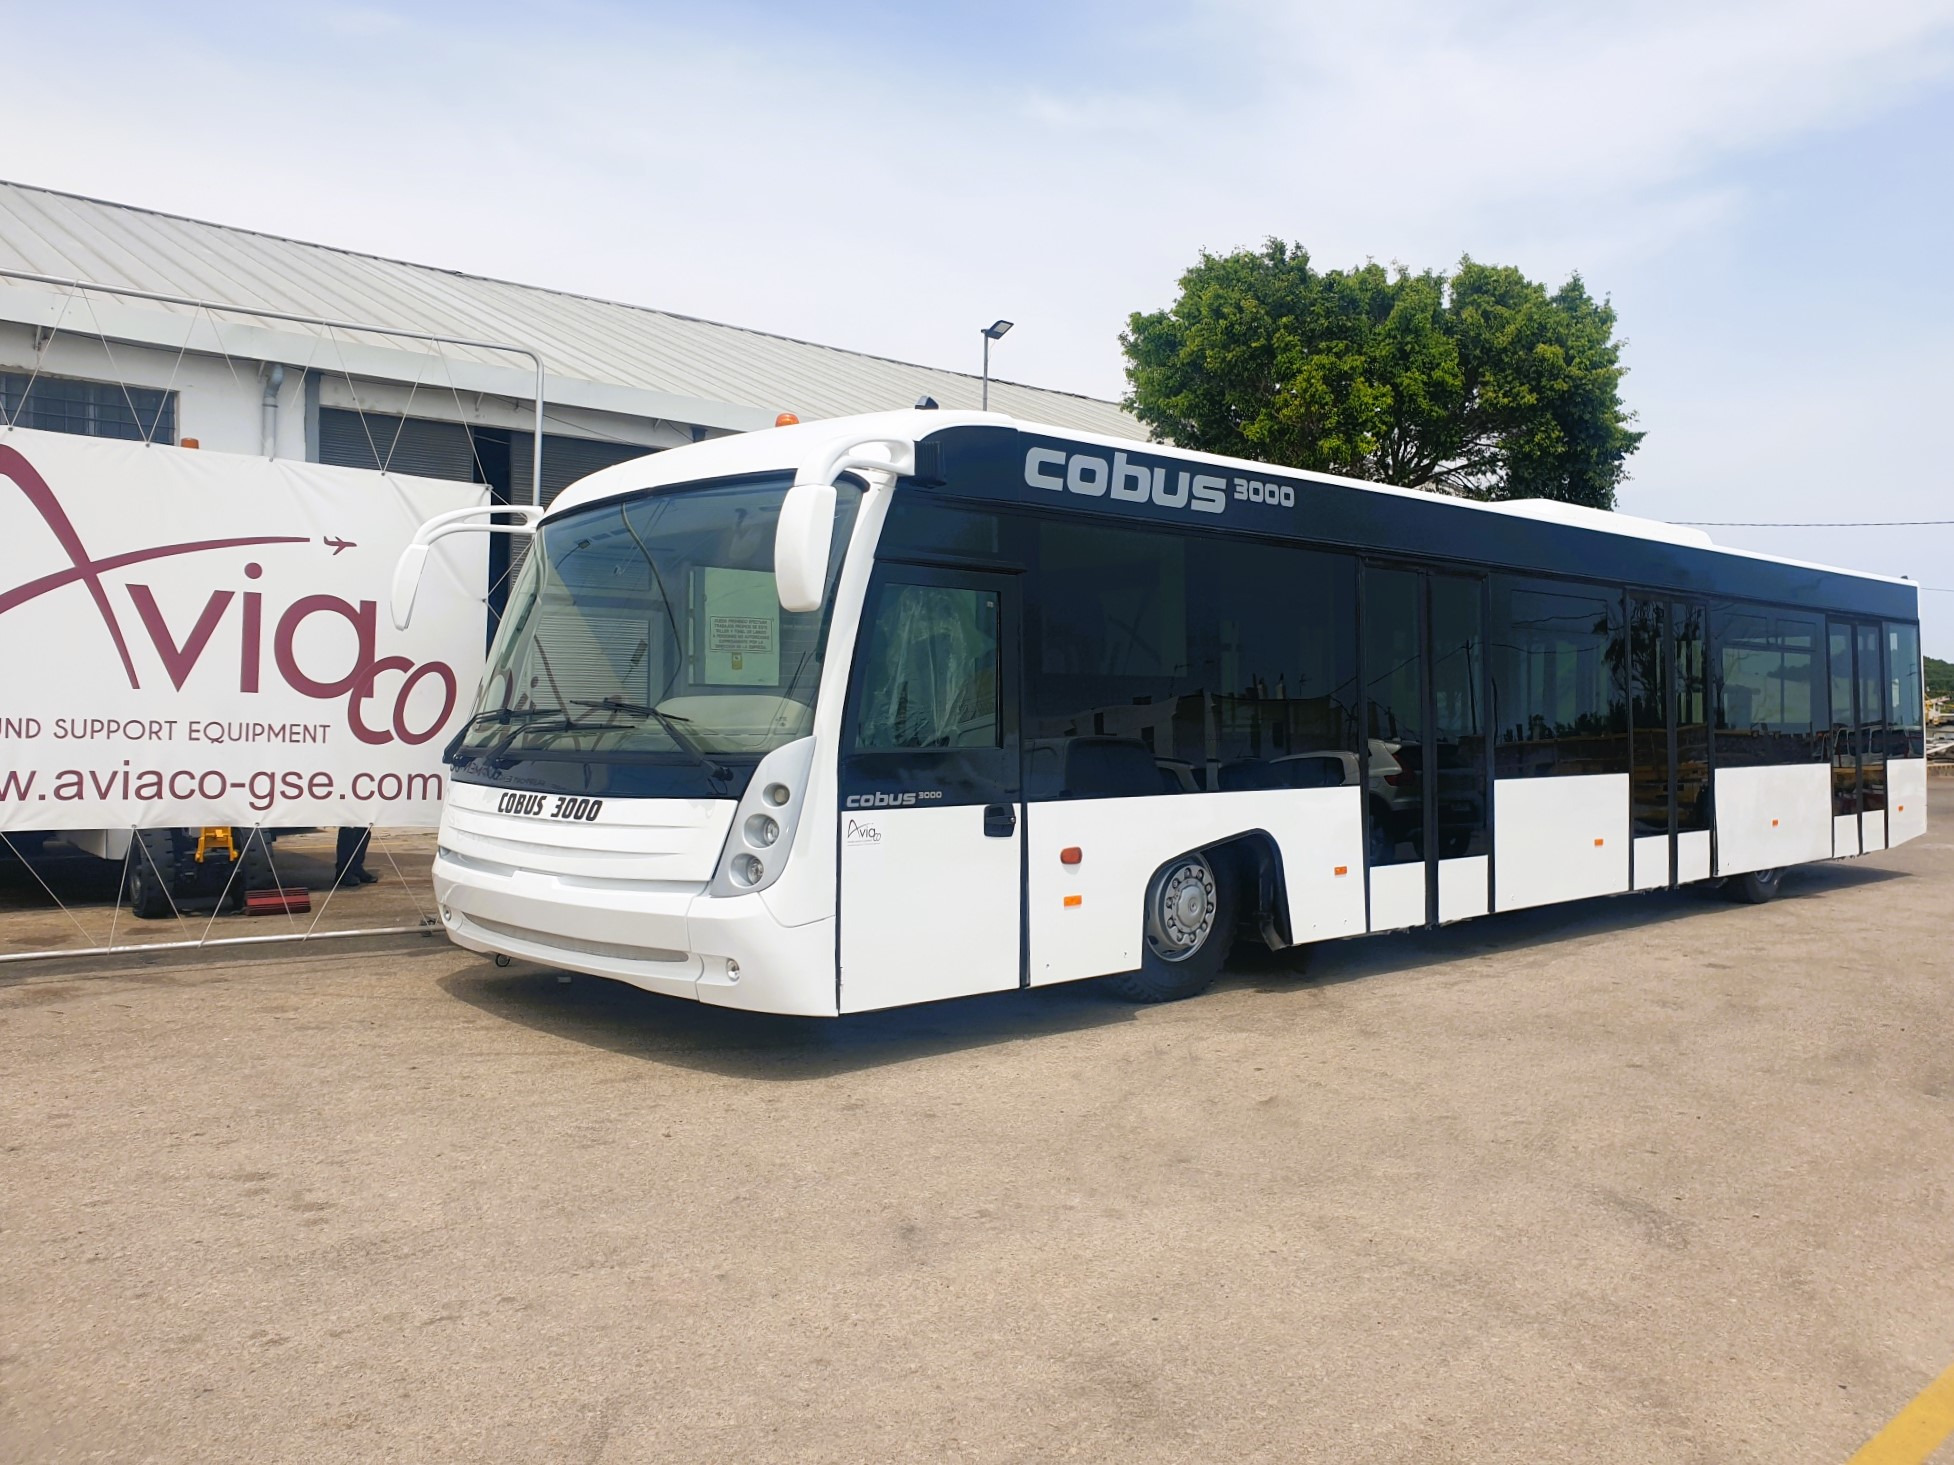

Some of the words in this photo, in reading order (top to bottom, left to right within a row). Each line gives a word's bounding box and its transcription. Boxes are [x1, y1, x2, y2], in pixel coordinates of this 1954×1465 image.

[1024, 447, 1227, 514] cobus
[1233, 477, 1295, 508] 3000
[0, 718, 41, 739] ND
[53, 718, 178, 741] SUPPORT
[188, 720, 331, 744] EQUIPMENT
[497, 792, 548, 816] COBUS
[550, 797, 603, 822] 3000
[846, 791, 917, 808] cobus
[918, 791, 943, 799] 3000
